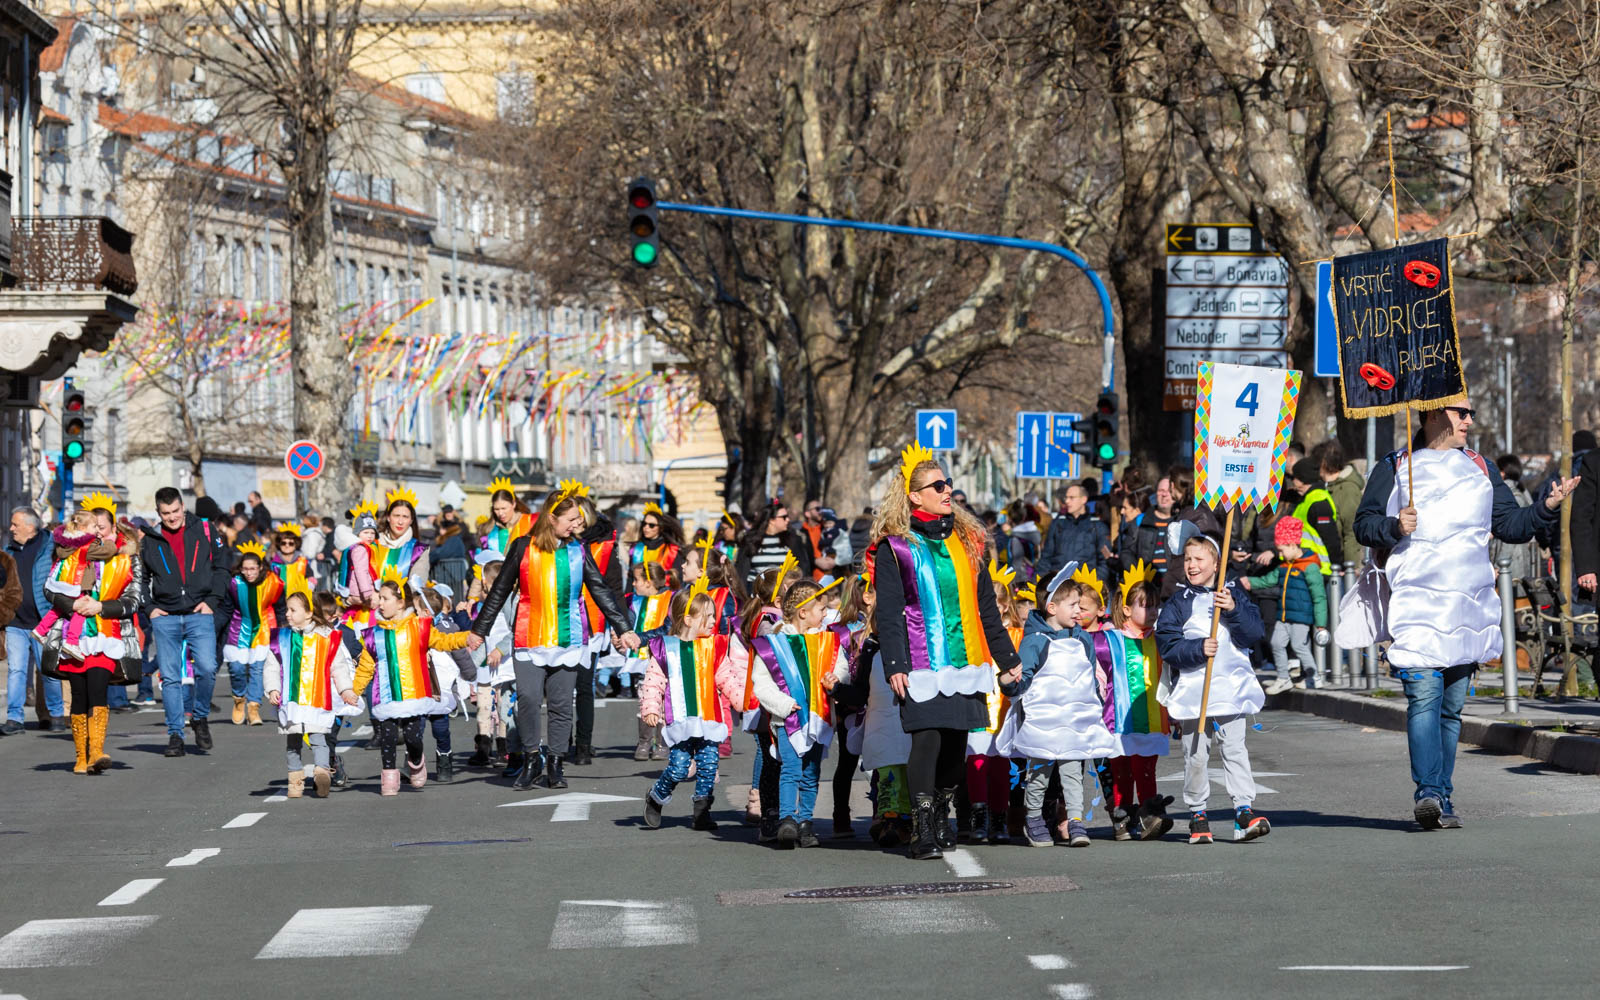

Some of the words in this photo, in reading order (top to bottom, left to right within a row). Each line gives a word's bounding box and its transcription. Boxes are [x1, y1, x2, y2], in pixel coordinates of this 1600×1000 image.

[1227, 266, 1277, 281] Bonavia
[1340, 265, 1393, 297] VRTIĆ
[1192, 297, 1236, 313] Jadran
[1176, 328, 1228, 344] Neboder
[1399, 339, 1455, 374] RIJEKA
[1235, 382, 1259, 417] 4
[1225, 463, 1248, 473] ERSTE
